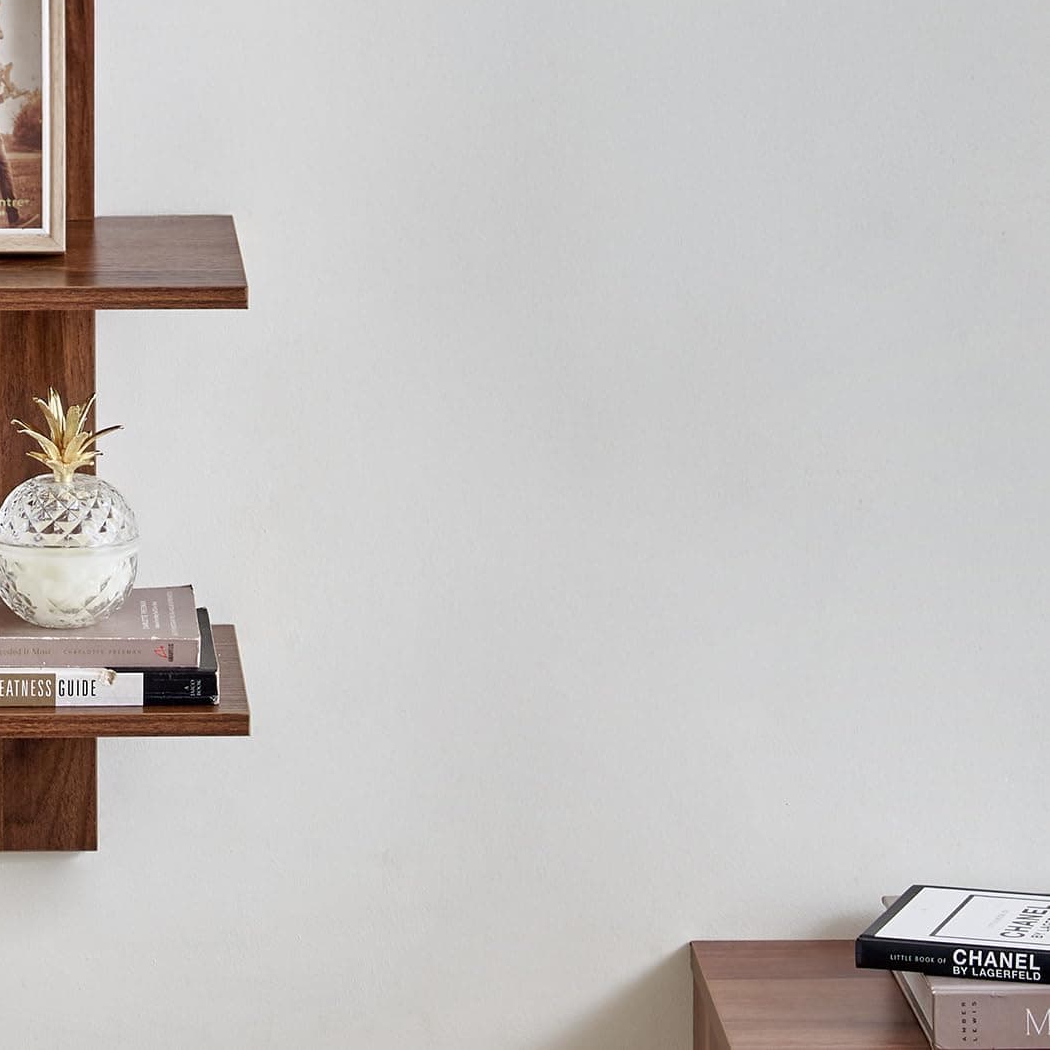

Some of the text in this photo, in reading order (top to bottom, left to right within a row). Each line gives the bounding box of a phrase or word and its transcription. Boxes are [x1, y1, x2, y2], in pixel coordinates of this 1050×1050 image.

[59, 679, 96, 697] GUIDE
[1000, 905, 1050, 938] CHANEL
[890, 953, 912, 962] LITTLE
[915, 955, 934, 963] BOOK
[953, 949, 1041, 970] CHANEL
[953, 966, 1041, 981] BY LAGERFELD
